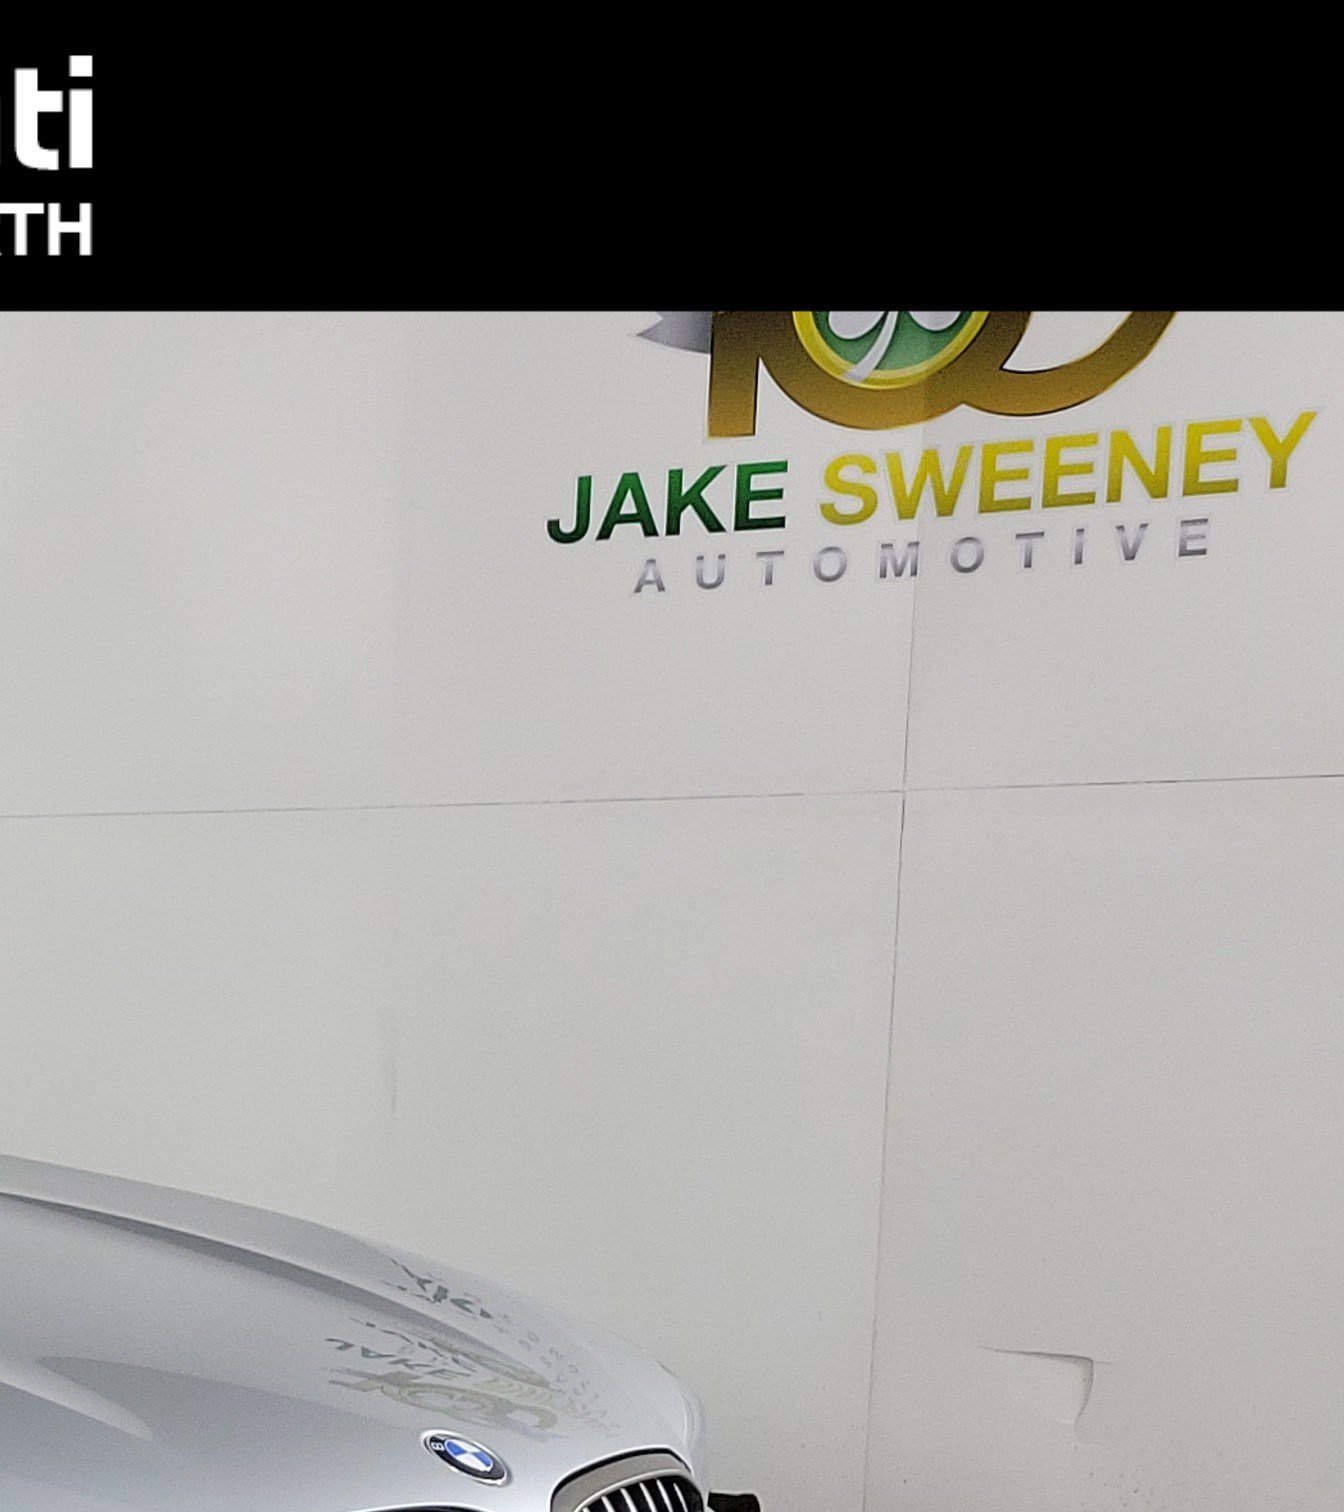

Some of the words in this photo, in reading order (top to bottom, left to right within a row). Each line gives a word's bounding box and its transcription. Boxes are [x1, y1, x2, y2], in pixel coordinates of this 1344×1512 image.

[546, 460, 788, 544] JAKE
[819, 411, 1317, 527] SWEENEY
[633, 518, 1210, 594] AUTOMOTIVE
